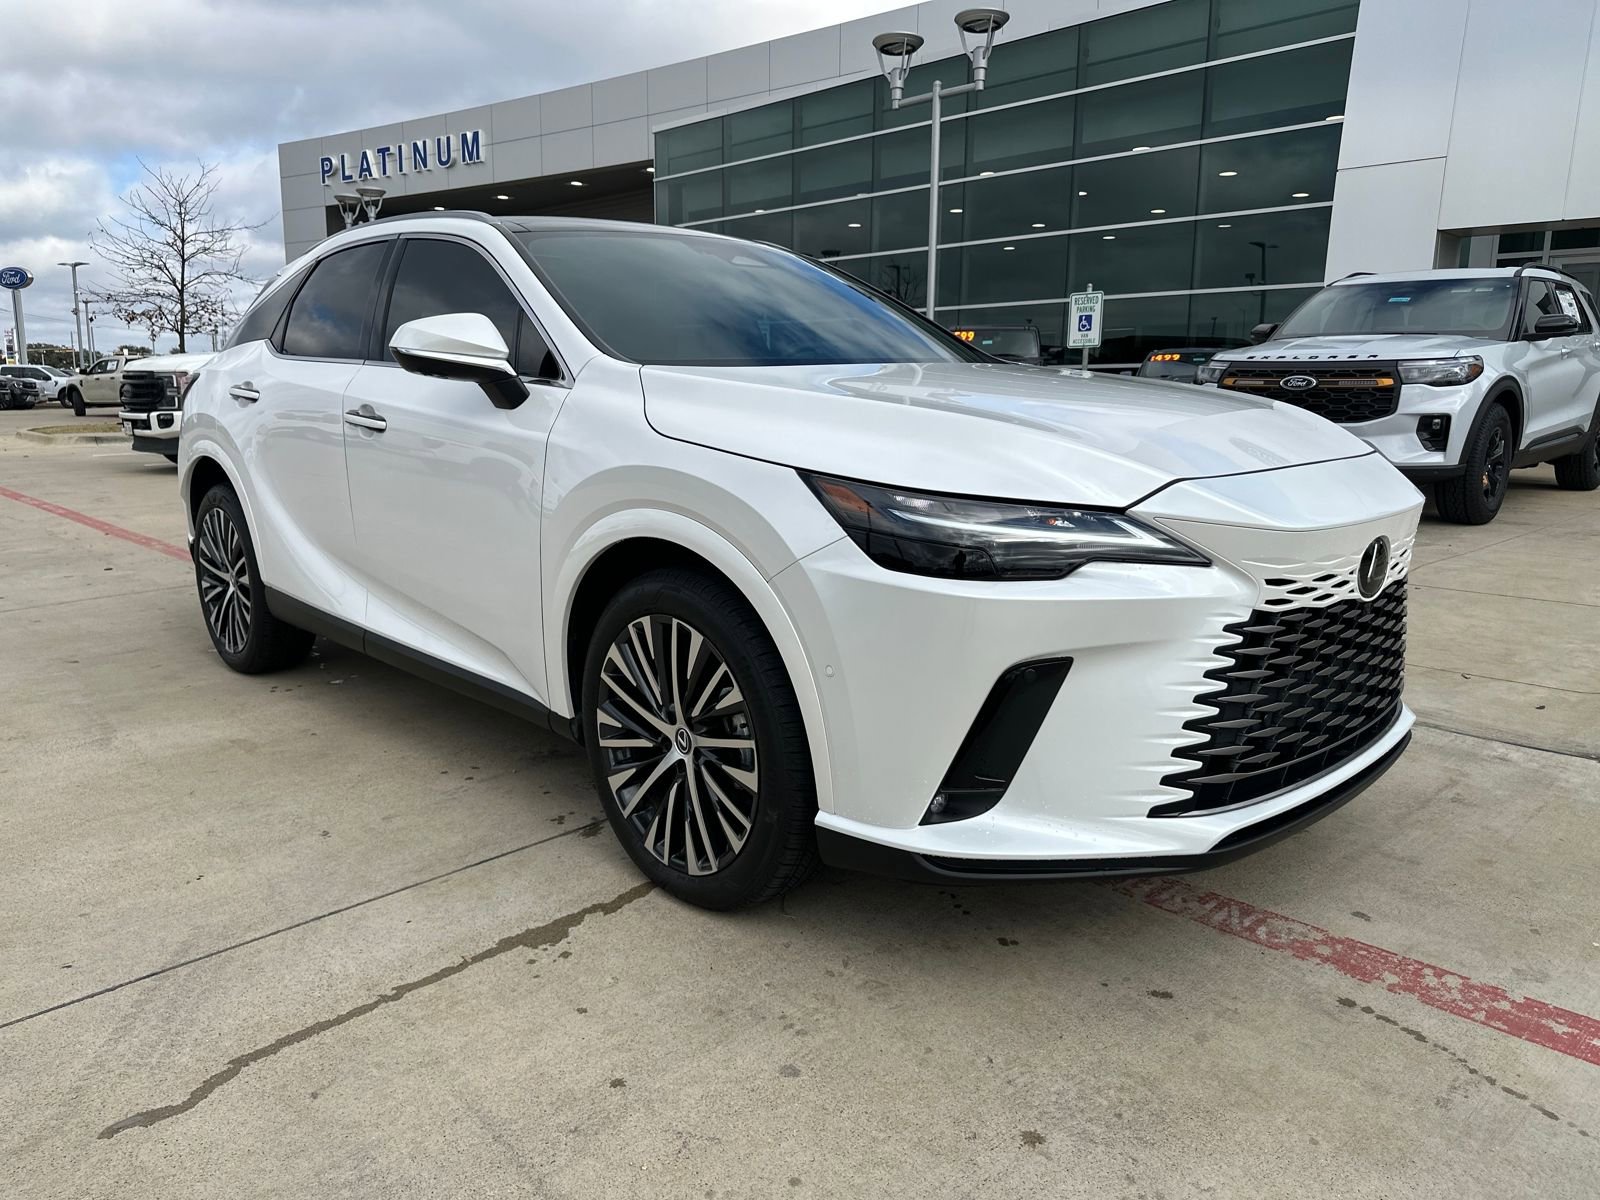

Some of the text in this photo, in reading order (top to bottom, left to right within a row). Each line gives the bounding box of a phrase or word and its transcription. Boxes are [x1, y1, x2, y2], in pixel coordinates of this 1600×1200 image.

[320, 129, 484, 185] PLATINUM
[2, 271, 20, 284] Ford
[1074, 296, 1100, 306] RESERVED
[1076, 305, 1096, 313] PARKING
[1287, 378, 1308, 387] Ford
